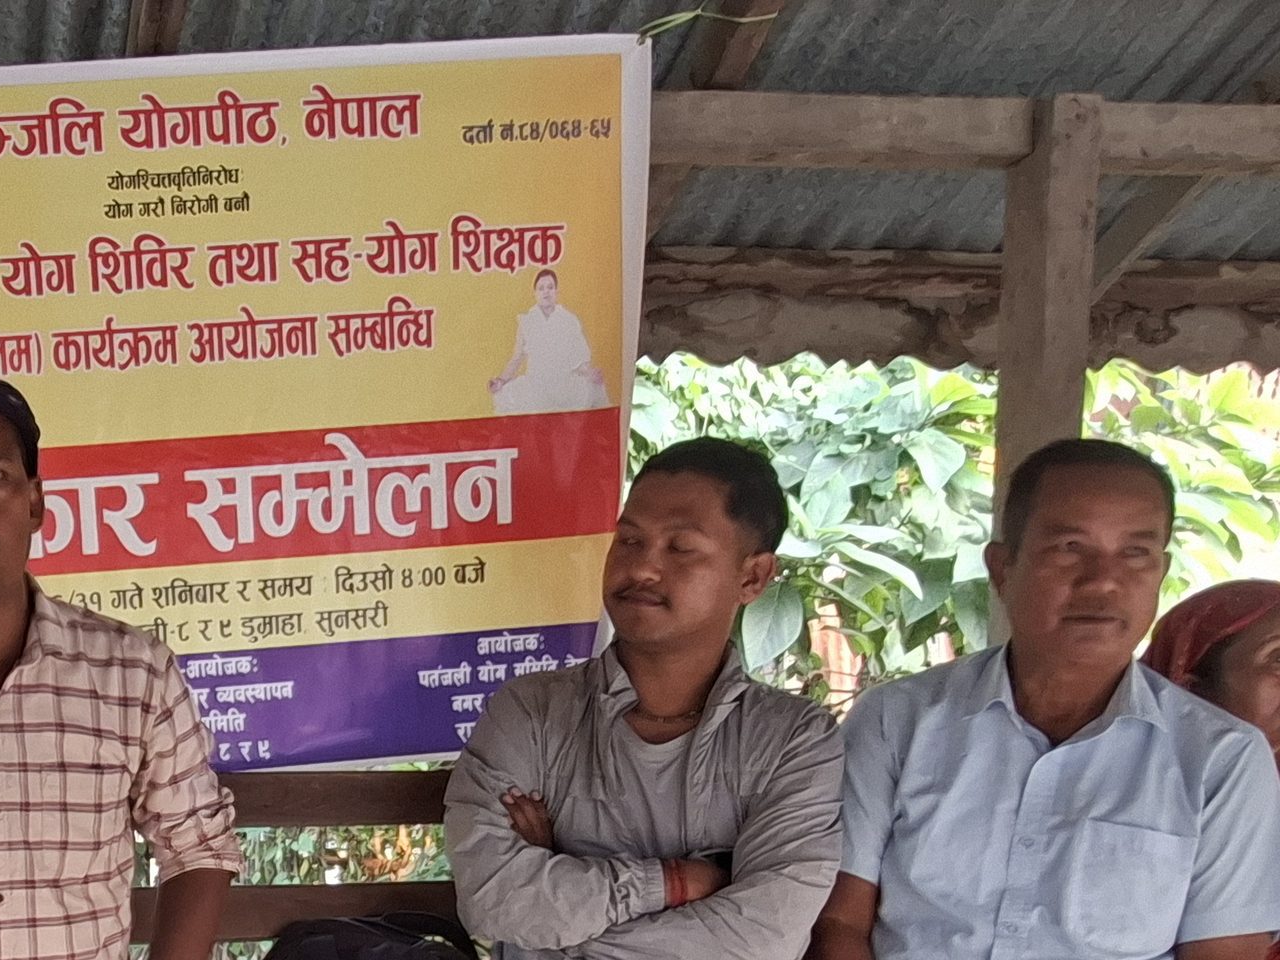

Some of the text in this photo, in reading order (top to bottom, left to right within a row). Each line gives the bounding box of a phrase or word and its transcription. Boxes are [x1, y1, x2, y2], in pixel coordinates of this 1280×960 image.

[118, 90, 288, 149] योगपीठ,
[303, 85, 422, 141] नेपाल
[462, 118, 494, 145] दर्ता
[104, 199, 133, 219] योग
[171, 194, 218, 216] निरोगी
[0, 242, 76, 296] योग
[89, 235, 195, 294] शिविर
[207, 241, 278, 287] तथा
[451, 215, 565, 273] शिक्षक
[51, 317, 178, 376] कार्यक्रम
[189, 306, 317, 363] आयोजना
[327, 296, 434, 357] सम्बन्धि
[183, 433, 518, 553] सम्मेलन
[110, 582, 144, 610] गते
[237, 579, 252, 602] र
[257, 575, 313, 602] समय
[334, 563, 394, 595] दिउसो
[198, 619, 213, 641] र
[315, 601, 389, 637] सुनसरी
